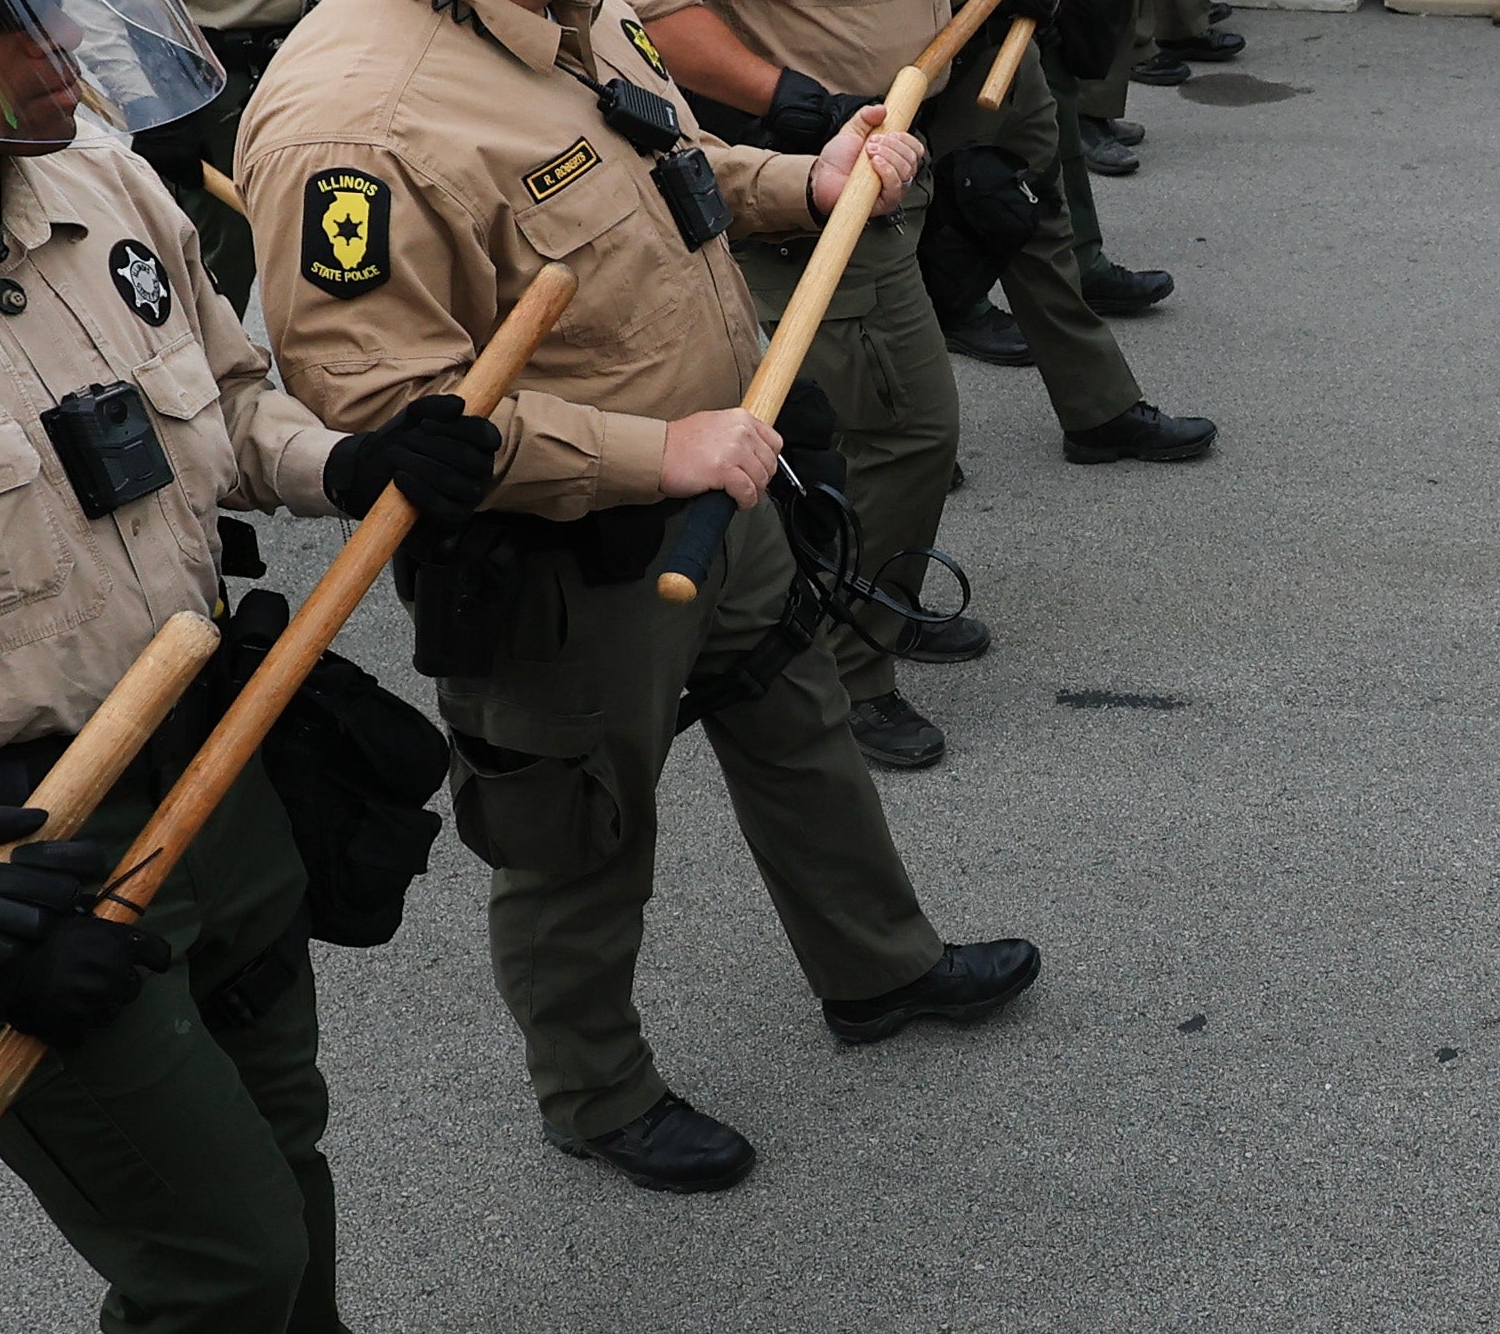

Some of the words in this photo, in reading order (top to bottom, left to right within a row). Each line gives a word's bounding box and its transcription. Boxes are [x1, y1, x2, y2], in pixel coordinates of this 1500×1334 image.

[317, 175, 379, 197] ILLINOIS
[310, 261, 342, 282] STATE
[344, 264, 381, 283] POLICE
